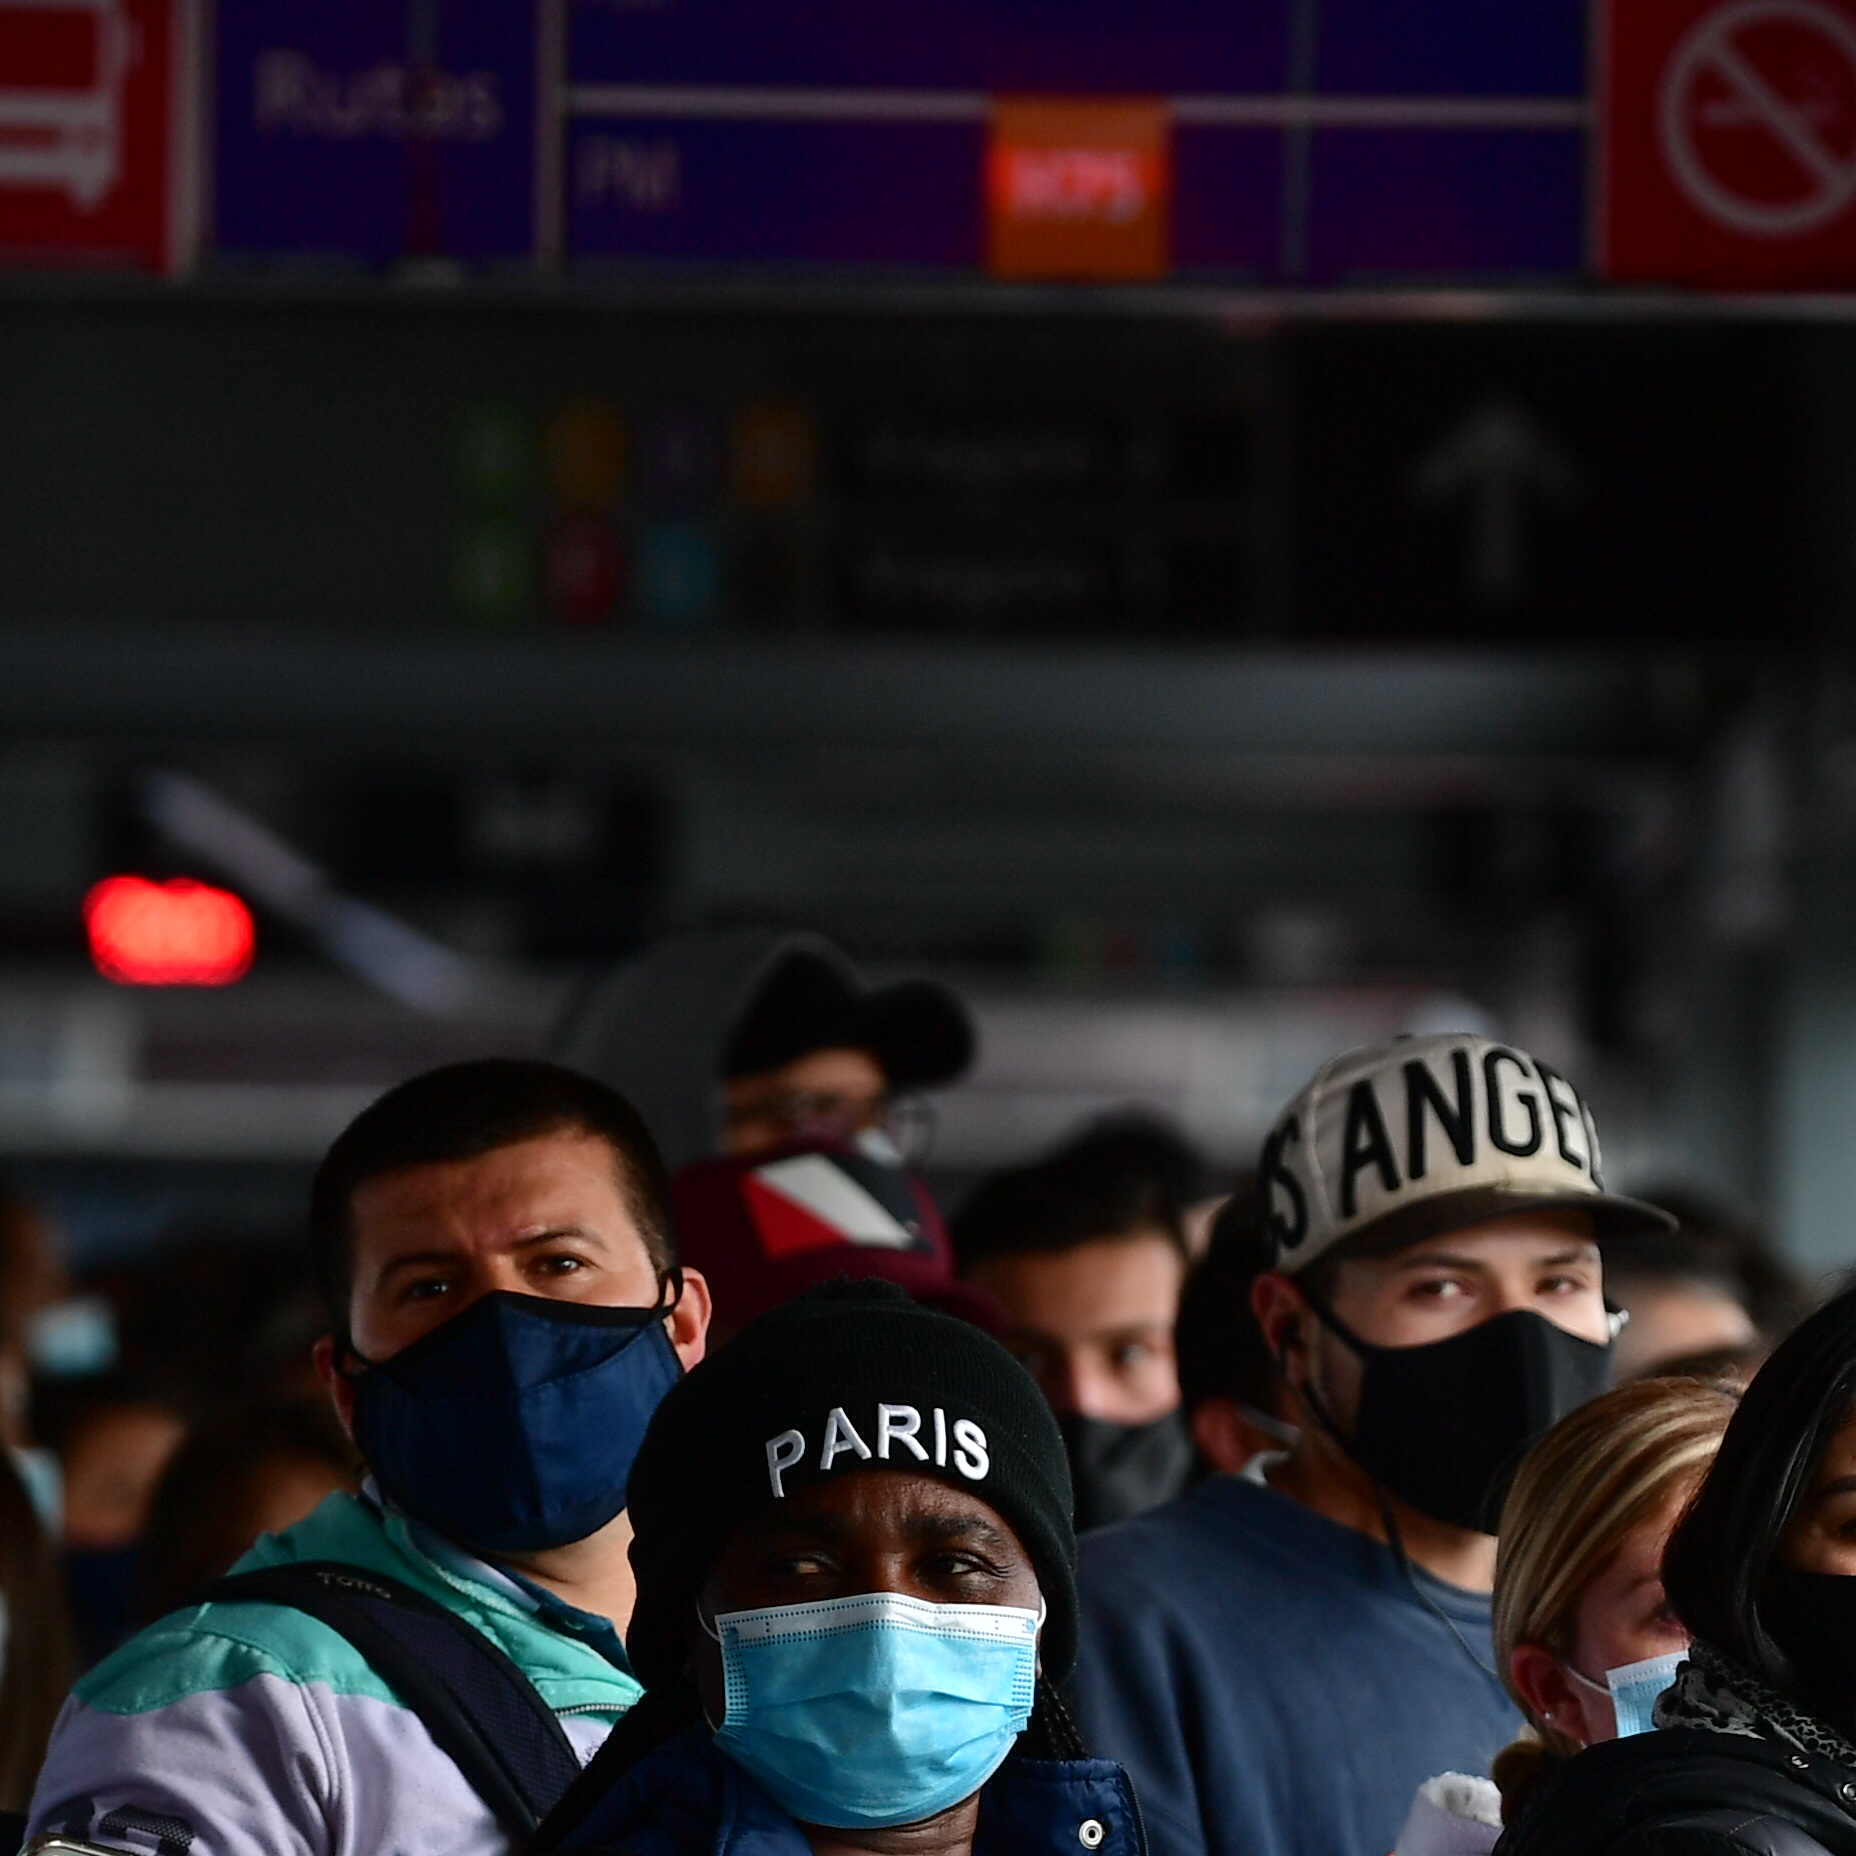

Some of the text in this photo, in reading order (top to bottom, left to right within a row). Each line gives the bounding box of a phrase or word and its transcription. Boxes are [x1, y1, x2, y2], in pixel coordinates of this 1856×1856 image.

[251, 46, 505, 142] Rutas
[1256, 1050, 1596, 1250] S ANGE
[764, 1402, 991, 1499] PARIS
